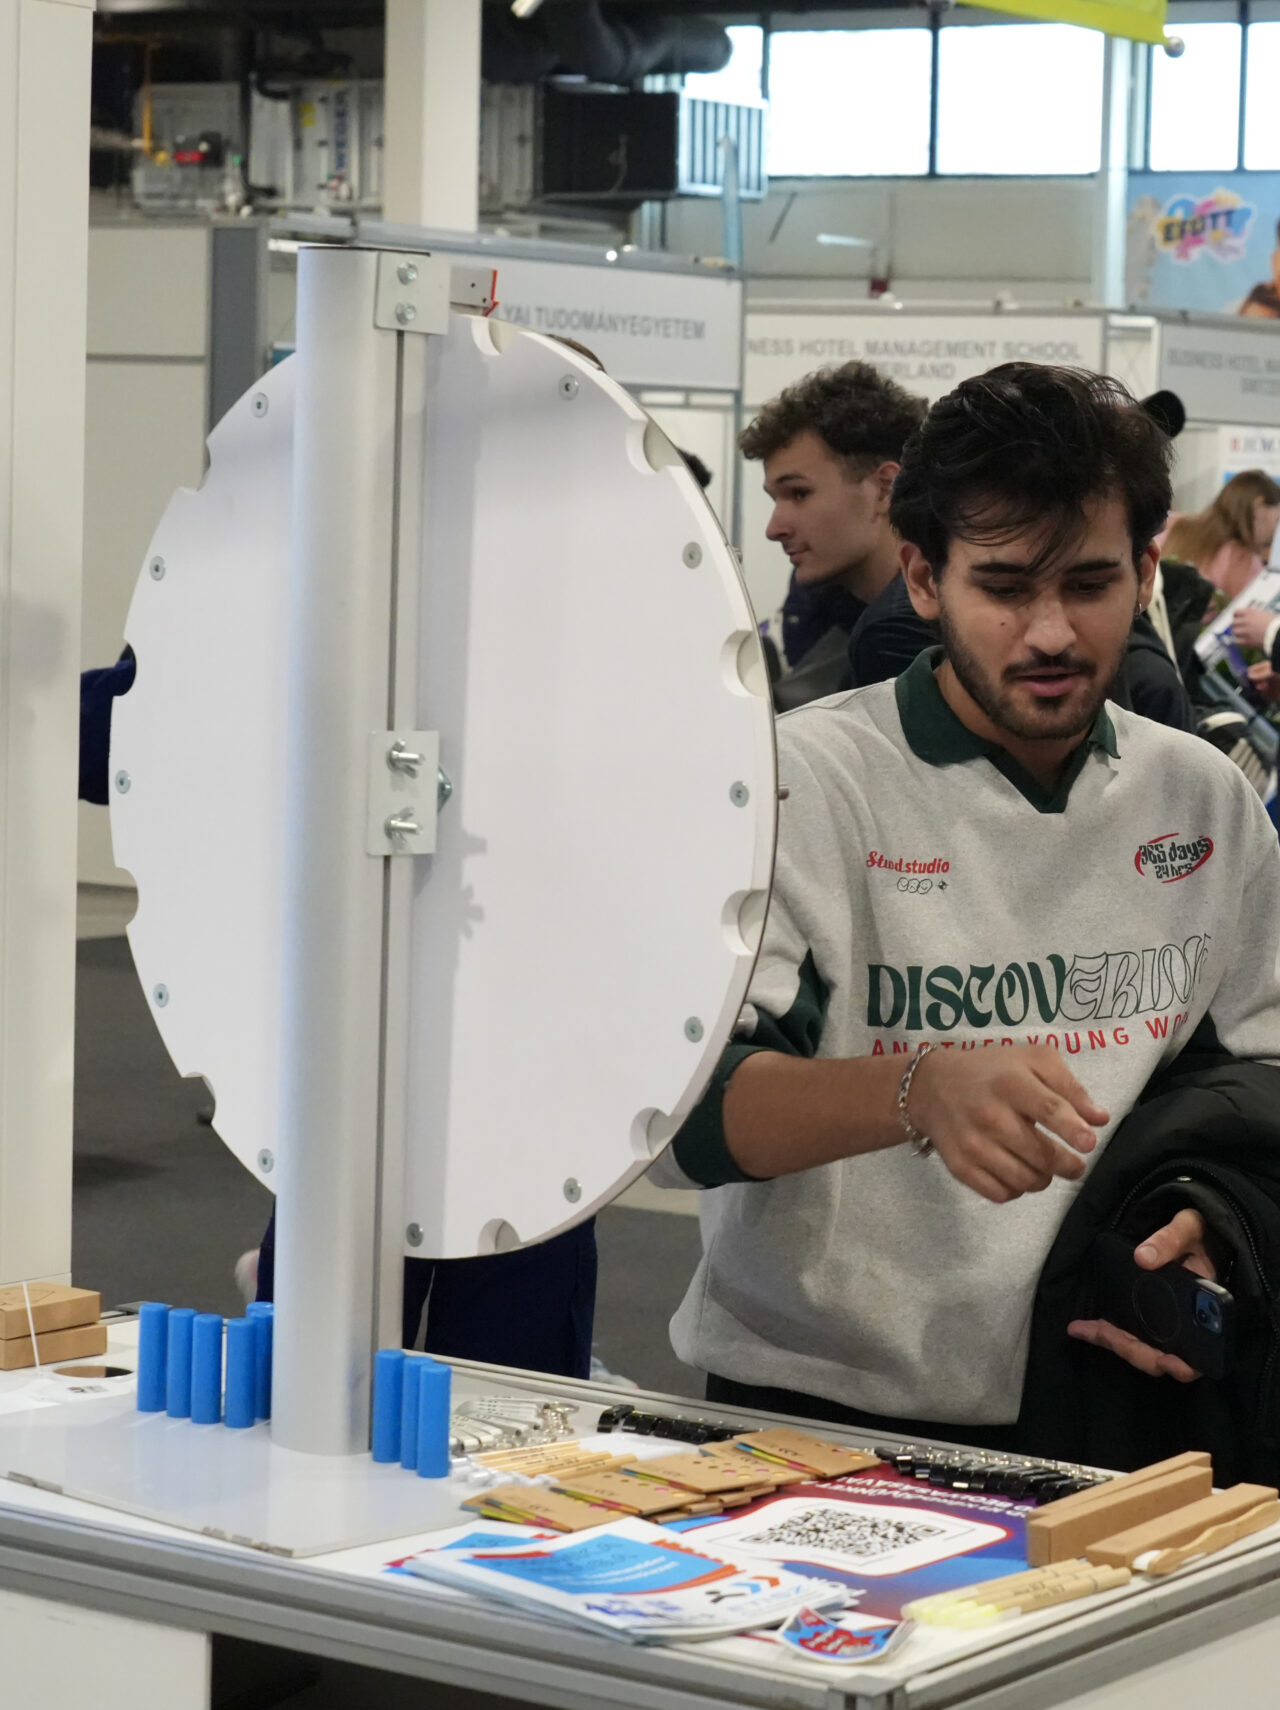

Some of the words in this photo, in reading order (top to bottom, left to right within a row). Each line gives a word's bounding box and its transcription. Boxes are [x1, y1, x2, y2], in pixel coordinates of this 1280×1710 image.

[536, 305, 707, 340] TUDOMÁNYEGYETEM
[799, 338, 860, 358] HOTEL
[865, 339, 998, 359] MANAGEMENT
[1002, 340, 1082, 361] SCHOOL
[1138, 842, 1167, 865] 365
[1168, 838, 1211, 862] days
[1154, 864, 1170, 879] 24
[1171, 863, 1194, 877] hrs
